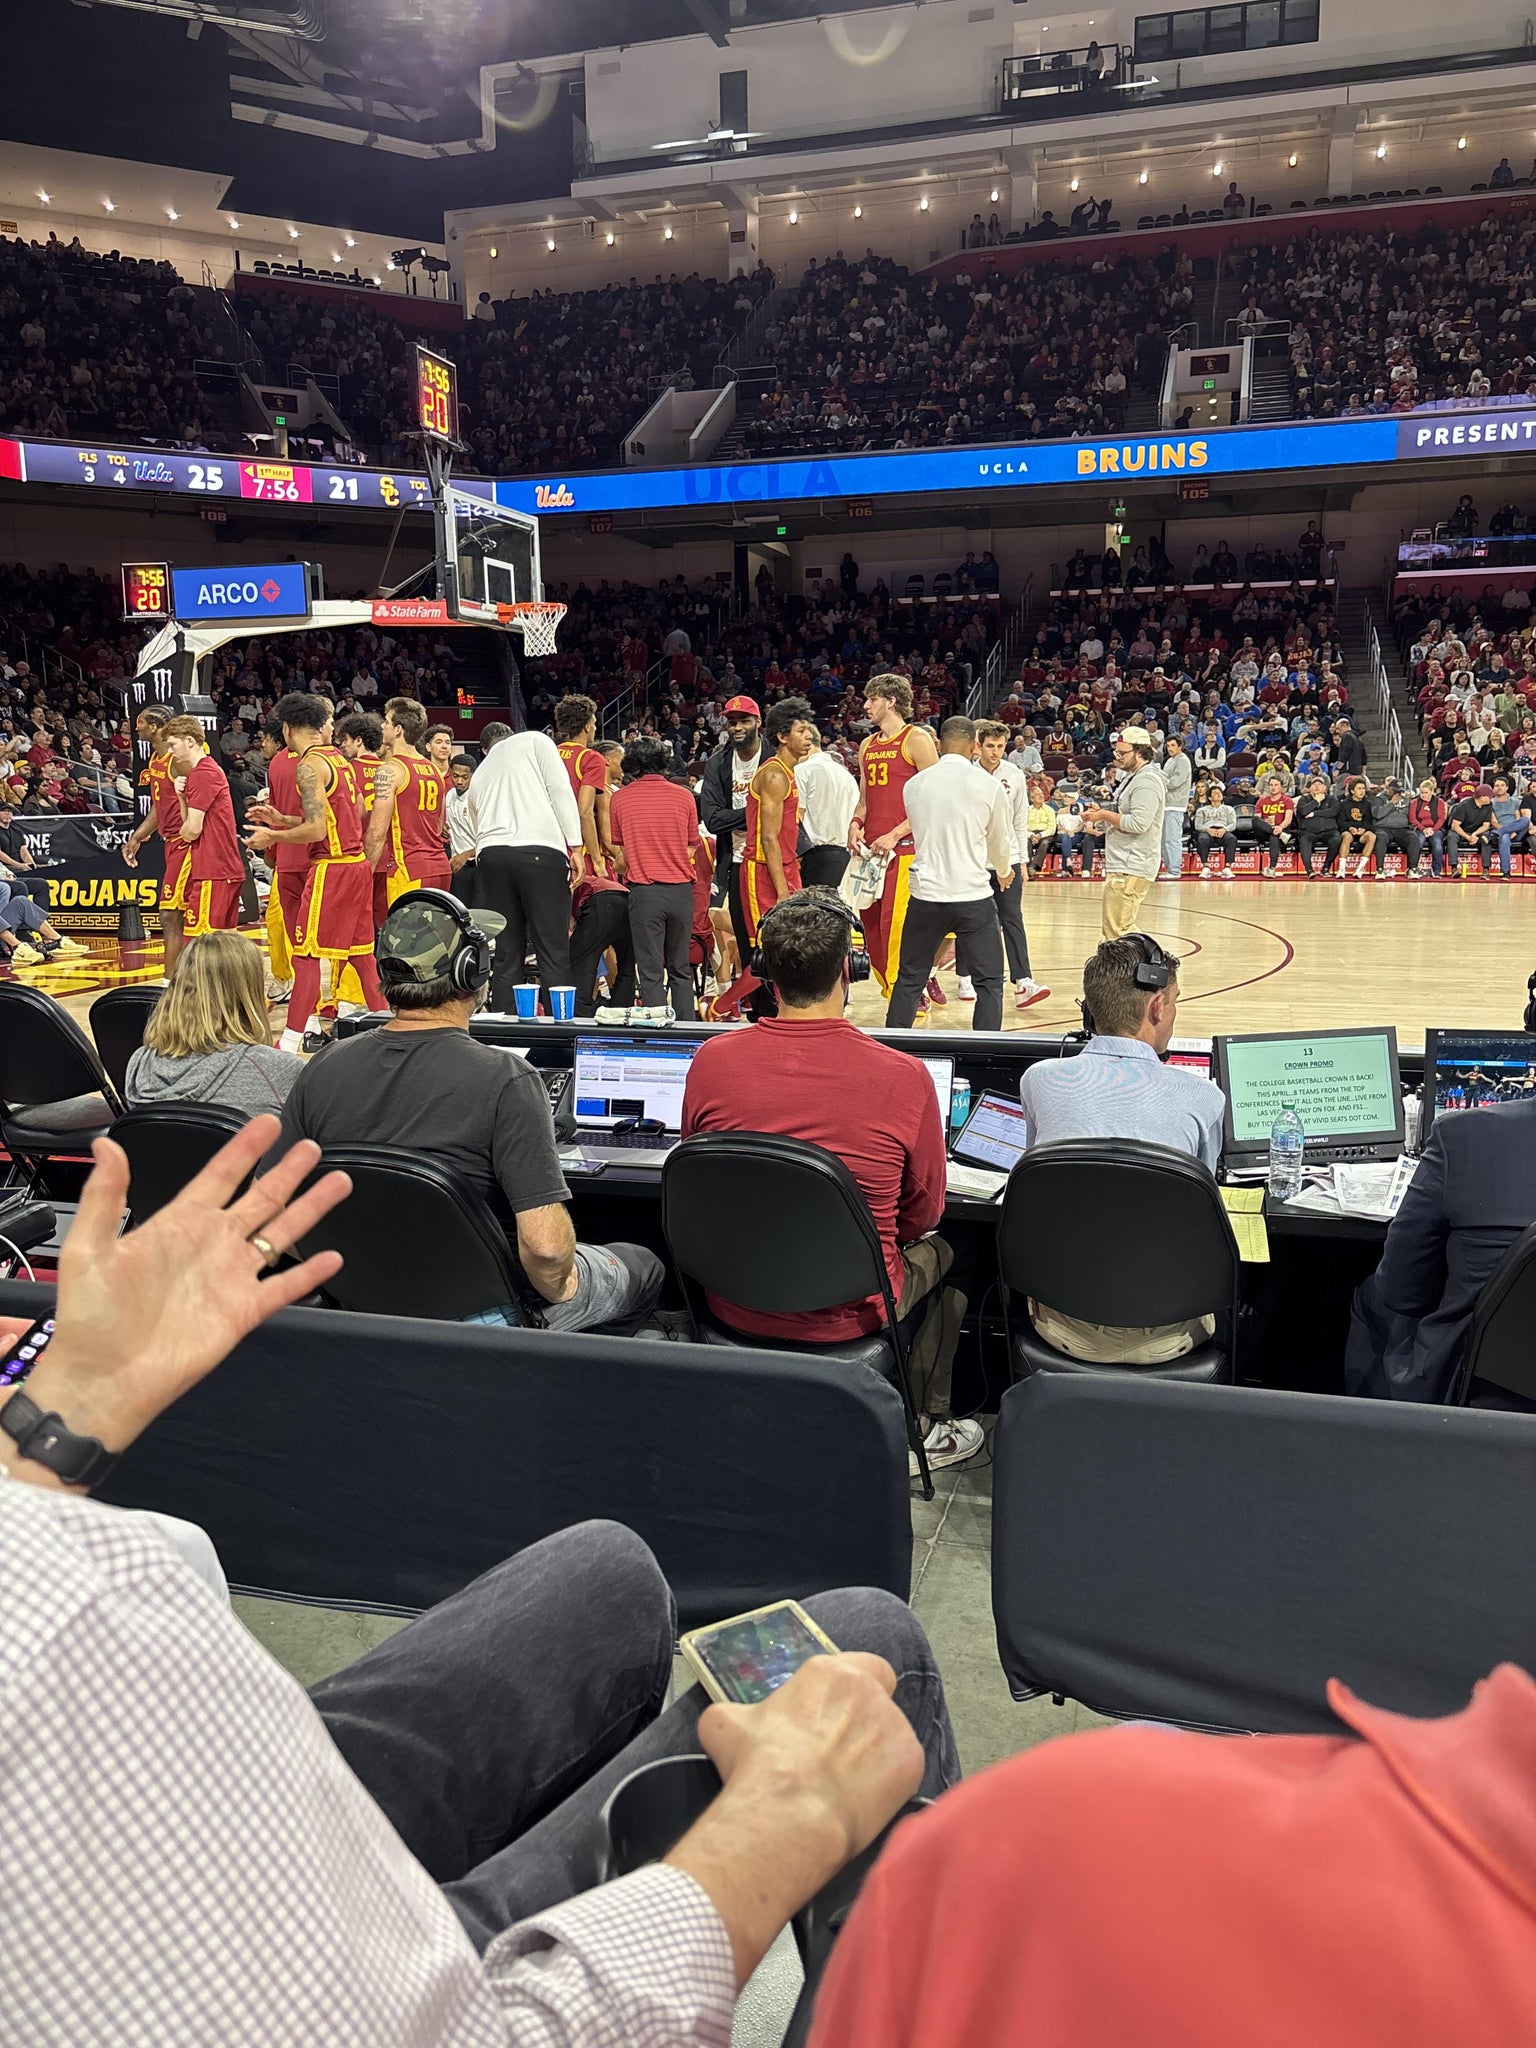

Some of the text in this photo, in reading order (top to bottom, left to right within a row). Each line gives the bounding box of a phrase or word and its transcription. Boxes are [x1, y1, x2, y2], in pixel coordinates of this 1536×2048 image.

[424, 360, 450, 393] 7:56
[423, 386, 449, 435] 20
[78, 452, 130, 467] FLS TOL
[1077, 441, 1208, 475] BRUINS
[84, 467, 127, 485] 3 4
[273, 468, 291, 478] HALF
[979, 461, 1028, 475] UCLA
[188, 464, 224, 491] 25
[409, 479, 428, 491] TOL
[684, 461, 842, 504] UCLA
[252, 479, 300, 500] 7:56
[329, 476, 359, 501] 21
[1182, 489, 1209, 500] 105
[848, 507, 873, 518] 106
[137, 569, 165, 587] 7:56
[137, 589, 161, 611] 20
[197, 582, 259, 606] ARCO
[865, 750, 898, 760] TROJANS
[867, 762, 889, 787] 33
[154, 780, 160, 801] 2
[344, 771, 356, 805] 5
[418, 779, 439, 811] 18
[1262, 803, 1285, 815] USC
[28, 879, 159, 908] ROJANS
[1303, 1048, 1313, 1056] 13
[1284, 1060, 1334, 1069] CROWN PROMO
[1260, 1079, 1286, 1087] COLLEGE
[1287, 1076, 1323, 1085] BASKETBALL
[1324, 1075, 1348, 1083] CROWN
[1356, 1073, 1374, 1081] BACK!
[1299, 1088, 1320, 1096] TEAMS
[1236, 1101, 1280, 1109] CONFERENCES
